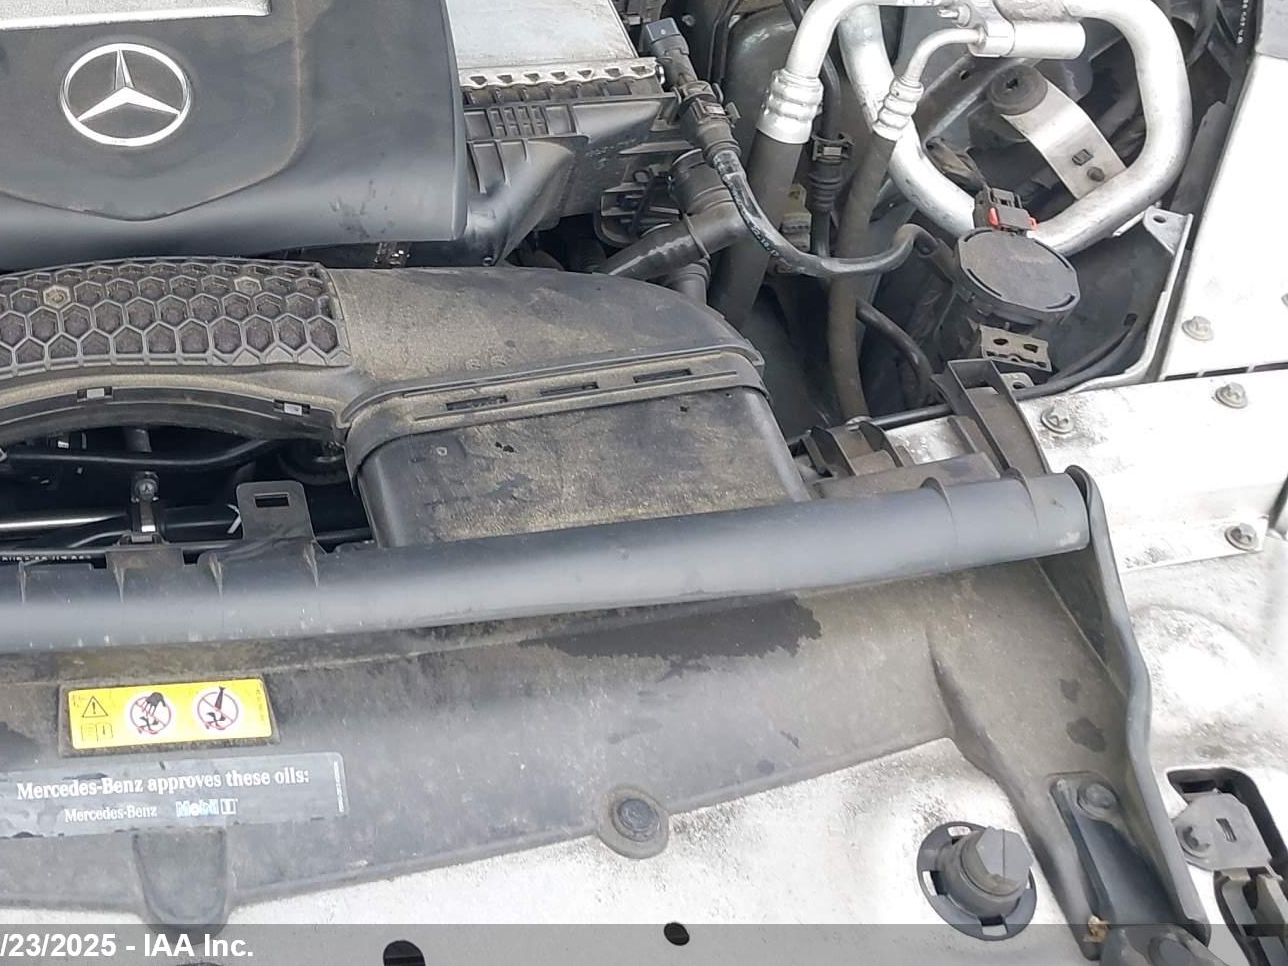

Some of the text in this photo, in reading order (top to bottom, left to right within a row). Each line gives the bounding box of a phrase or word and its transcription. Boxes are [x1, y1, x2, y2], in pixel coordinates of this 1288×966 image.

[16, 767, 310, 800] Mercedes-Benz approves these oils:
[64, 805, 158, 823] Mercedes-Benz
